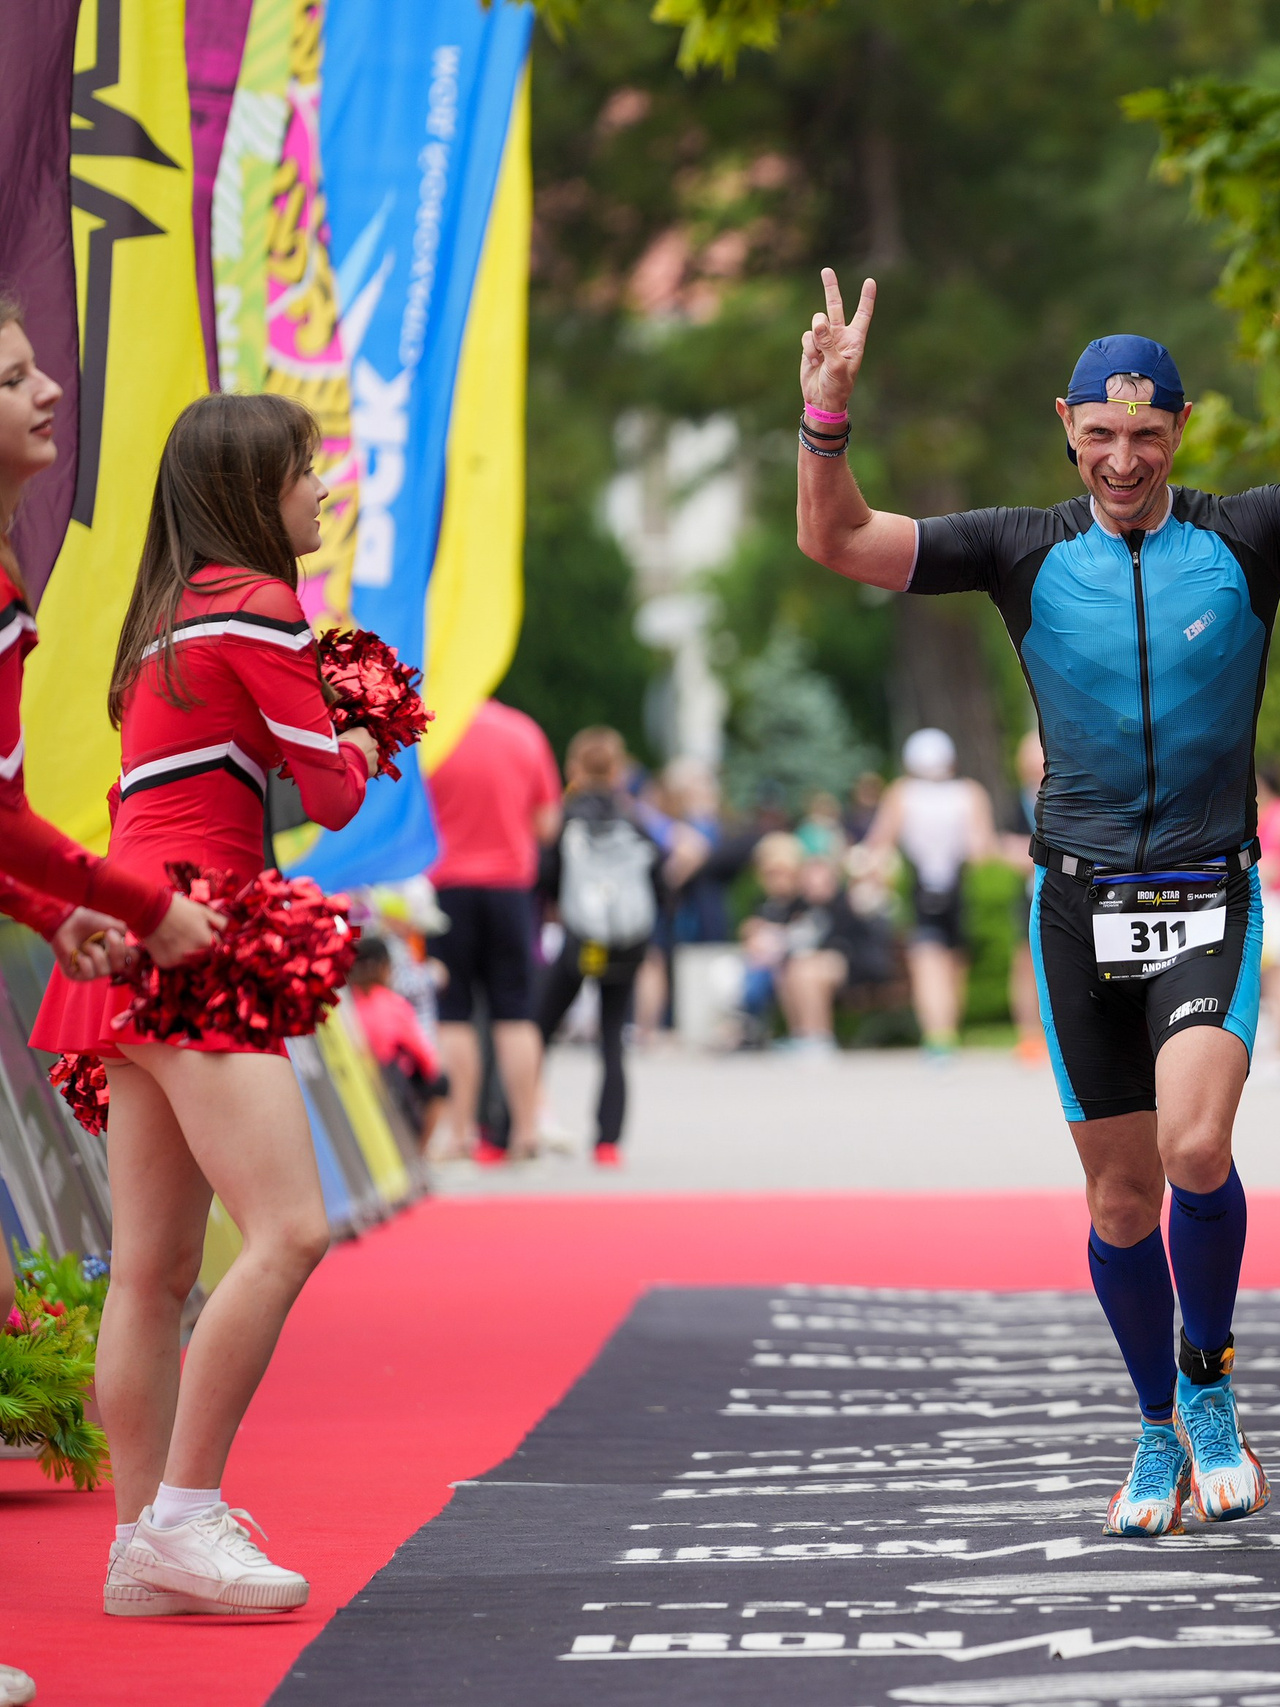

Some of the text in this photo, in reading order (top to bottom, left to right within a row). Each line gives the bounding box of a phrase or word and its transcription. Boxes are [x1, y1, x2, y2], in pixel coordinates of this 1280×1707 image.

[1137, 890, 1180, 900] IRON STAR
[1130, 920, 1187, 953] 311
[1142, 956, 1177, 973] ANDREY
[622, 1538, 968, 1560] IRON
[571, 1631, 966, 1653] IRON
